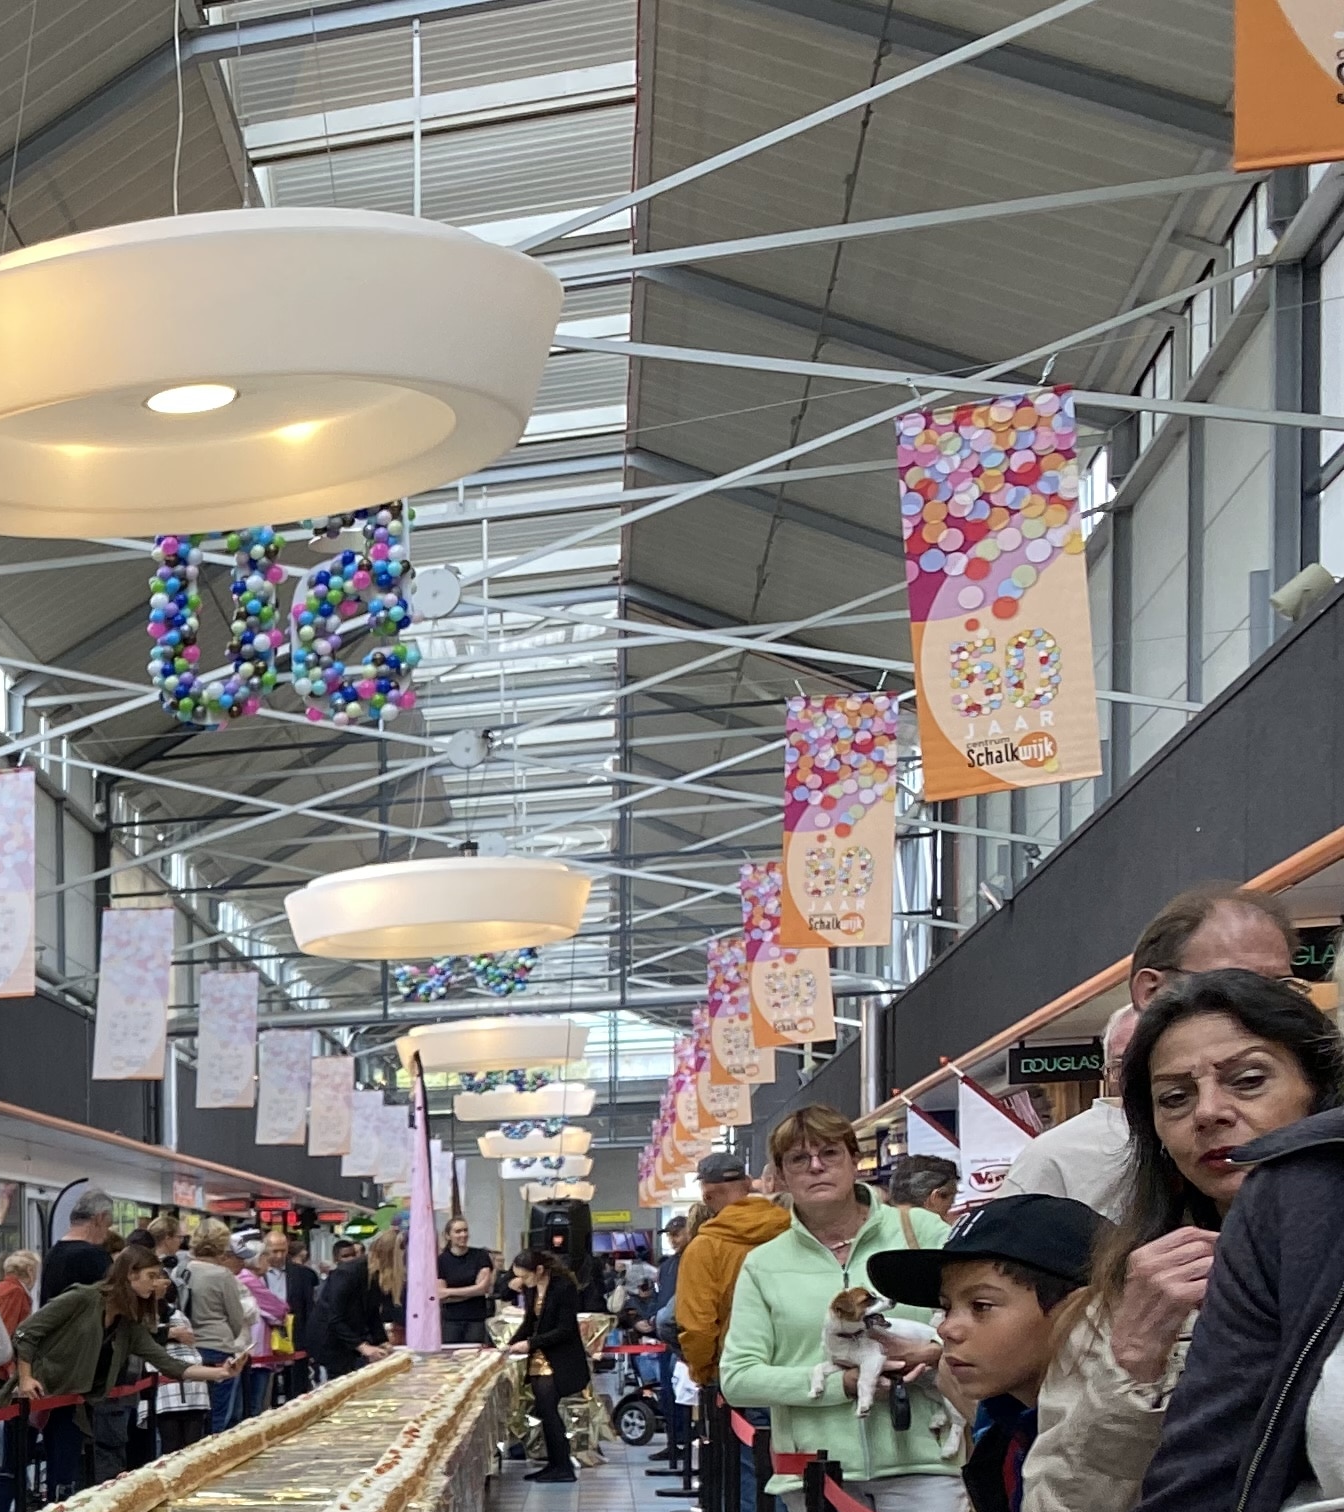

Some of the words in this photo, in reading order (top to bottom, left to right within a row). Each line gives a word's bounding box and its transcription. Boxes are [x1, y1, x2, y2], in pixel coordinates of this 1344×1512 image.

[949, 627, 1062, 718] 50
[964, 710, 1054, 739] JAAR
[966, 737, 1010, 749] centrum
[967, 736, 1054, 768] Schalkwijk
[1020, 1055, 1100, 1073] DOUGLAS
